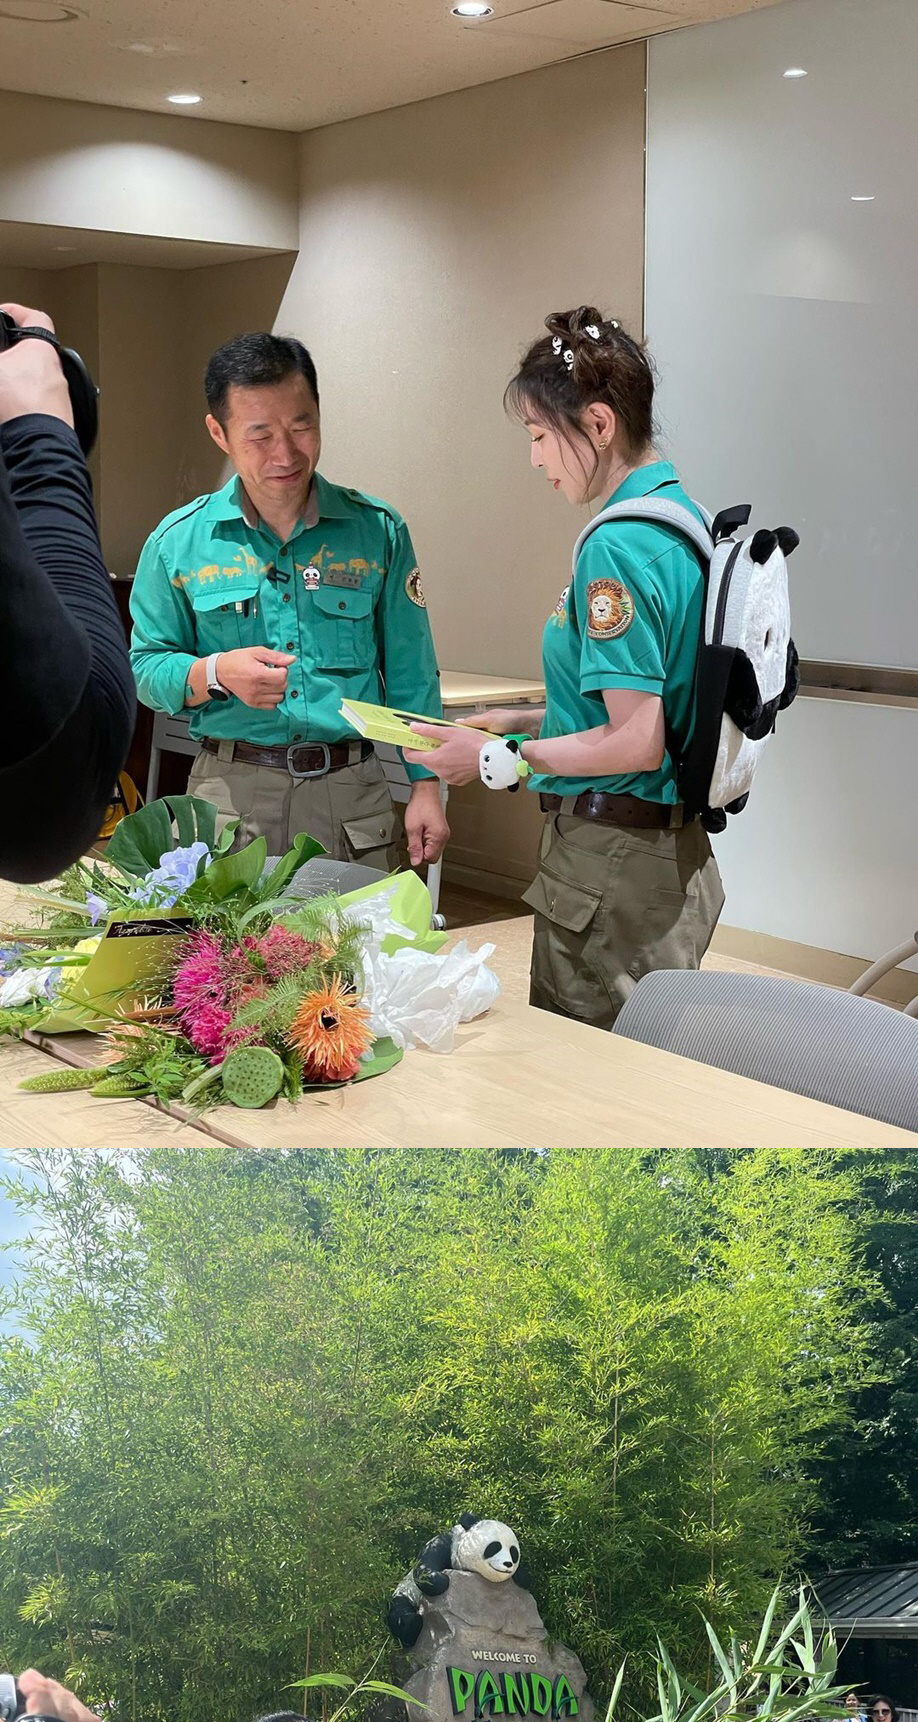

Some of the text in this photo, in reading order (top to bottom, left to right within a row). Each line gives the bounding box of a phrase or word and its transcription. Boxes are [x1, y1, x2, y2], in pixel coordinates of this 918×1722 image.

[472, 1650, 537, 1664] WELCOME TO
[446, 1666, 579, 1720] PANDA
